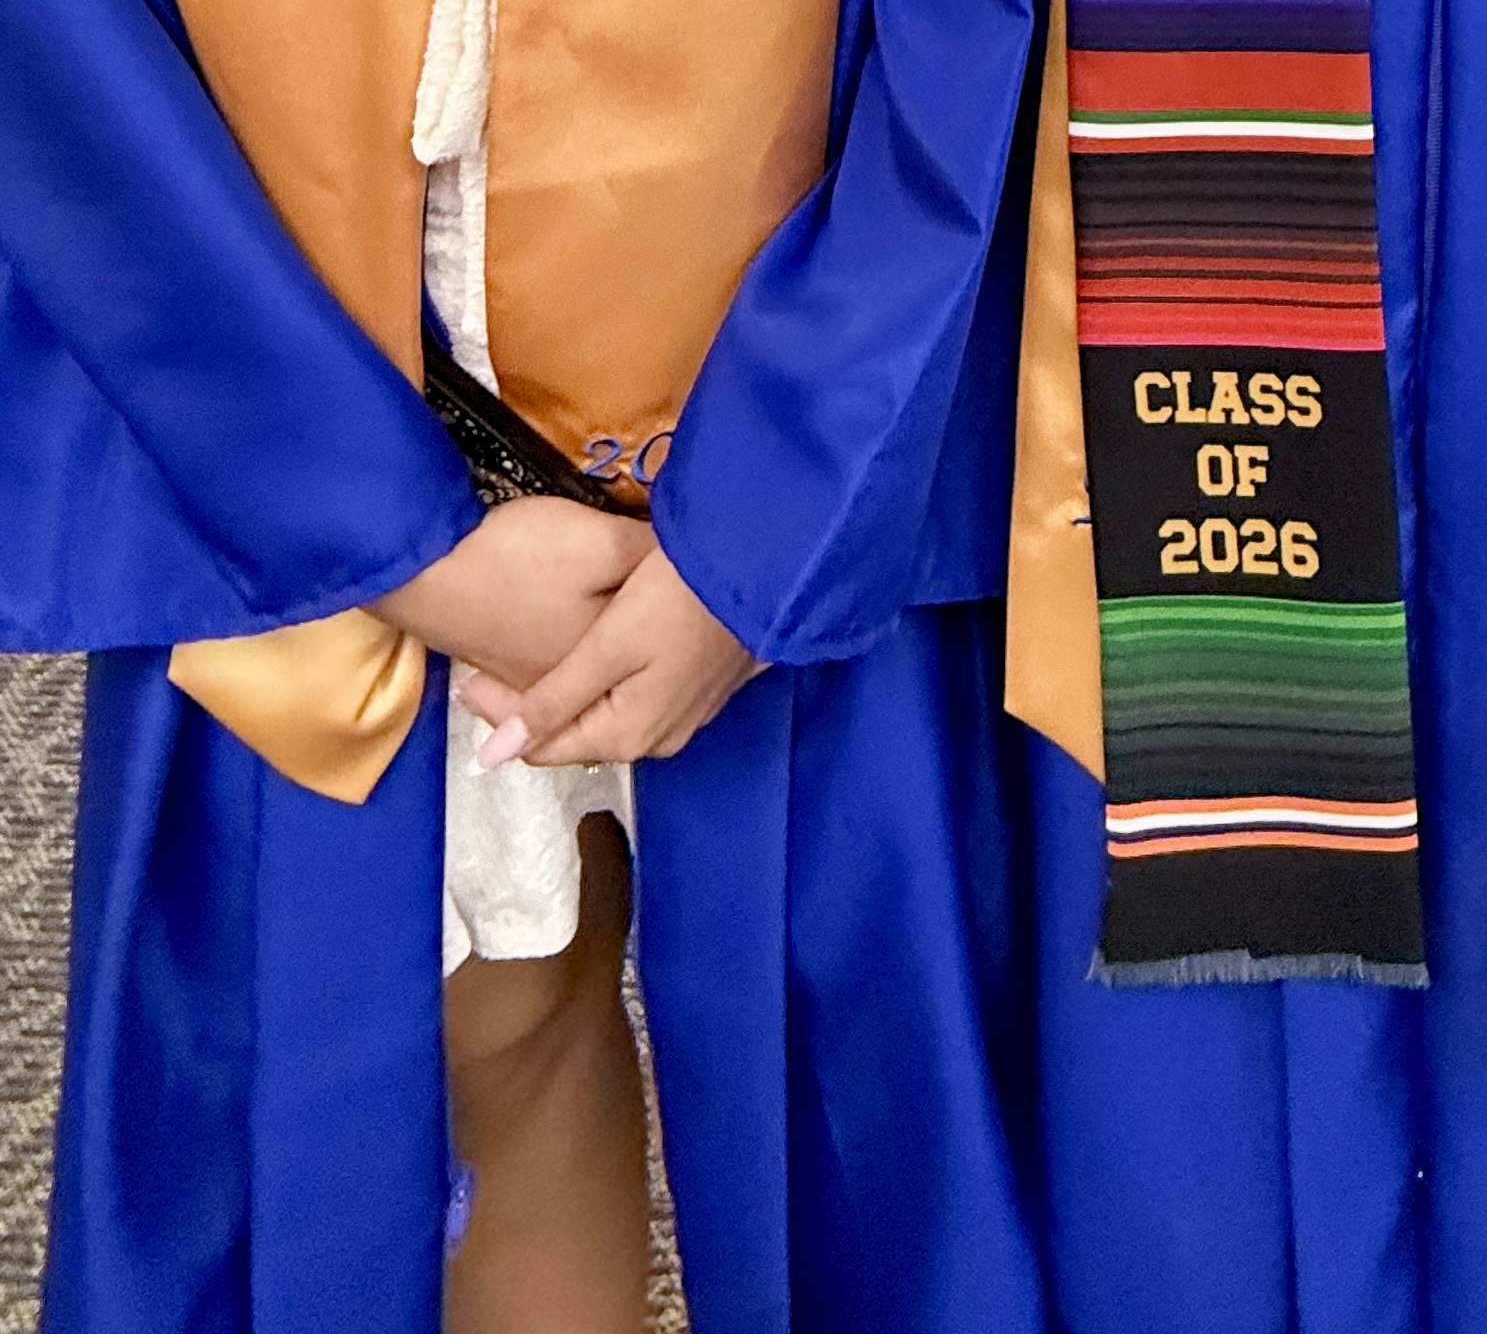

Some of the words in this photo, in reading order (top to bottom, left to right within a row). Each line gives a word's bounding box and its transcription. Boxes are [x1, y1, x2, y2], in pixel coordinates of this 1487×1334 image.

[1133, 370, 1324, 428] CLASS
[581, 431, 675, 486] 20
[1196, 442, 1270, 497] OF
[1157, 517, 1321, 579] 2026
